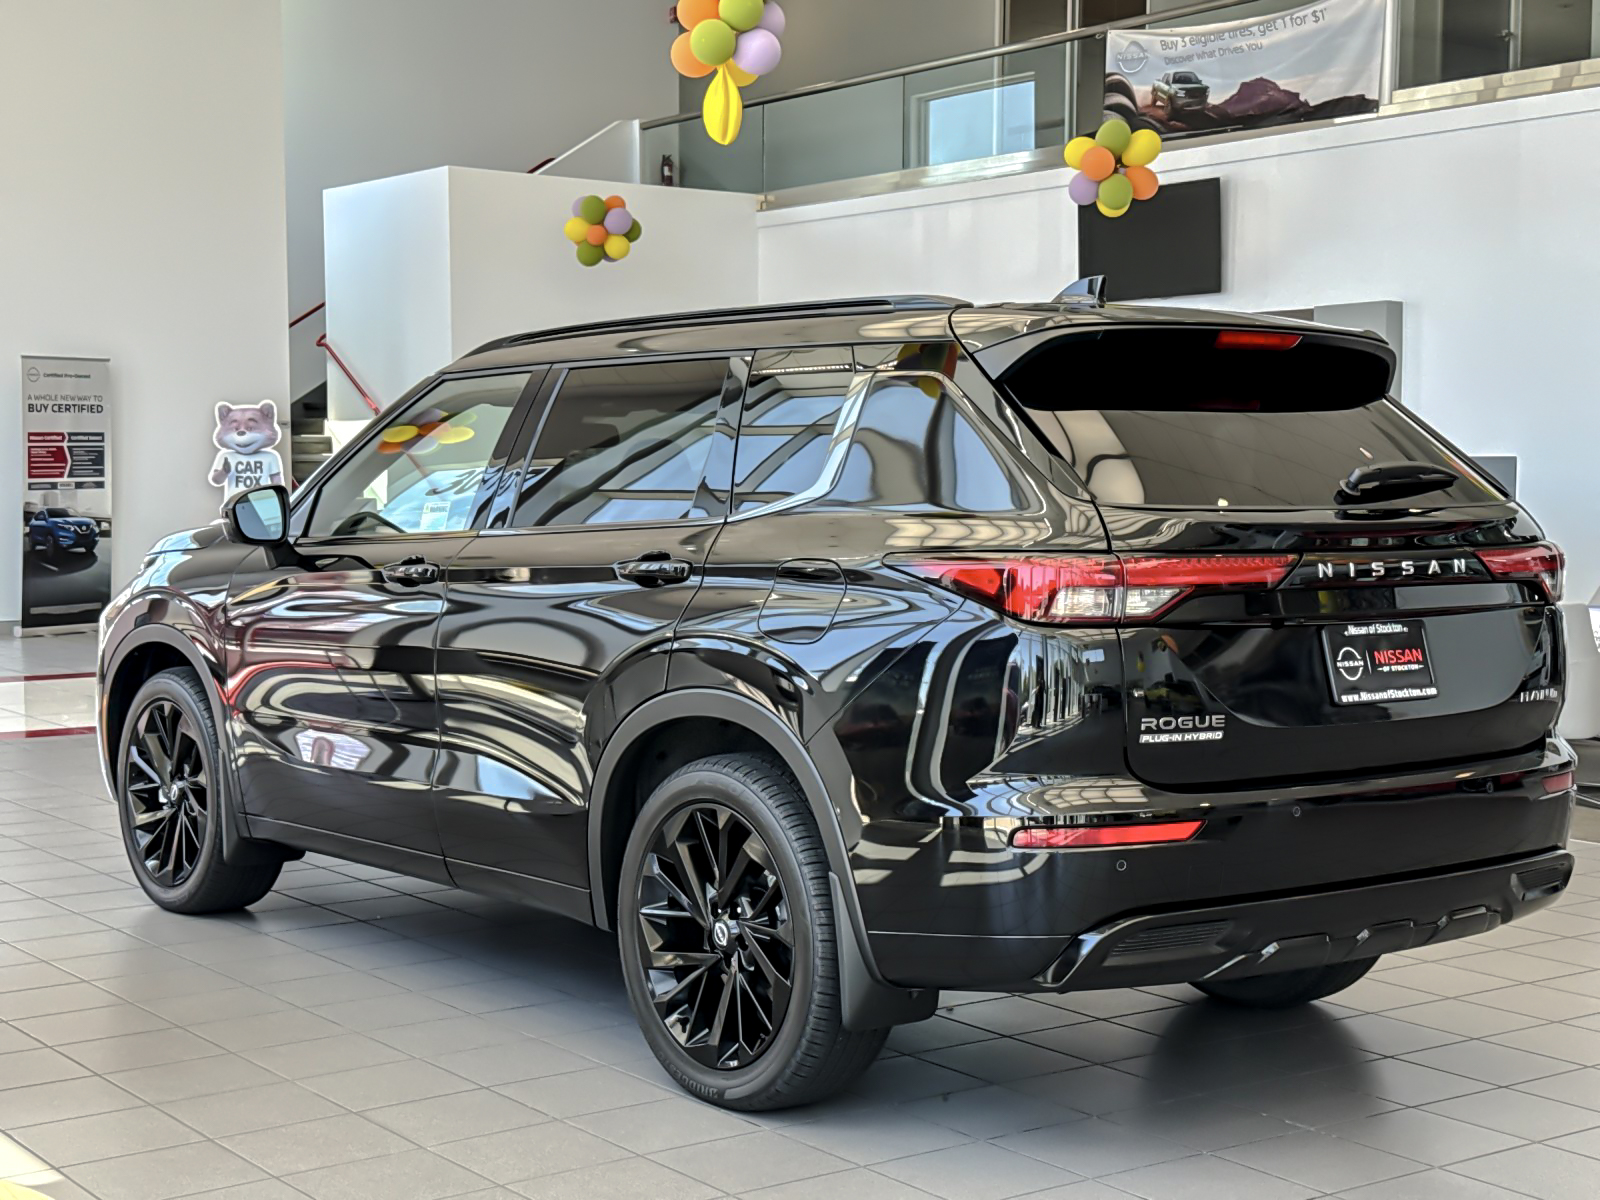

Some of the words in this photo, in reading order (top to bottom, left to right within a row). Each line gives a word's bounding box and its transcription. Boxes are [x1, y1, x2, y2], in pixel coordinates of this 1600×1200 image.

[1160, 39, 1179, 51] Buy
[1257, 20, 1279, 37] get
[1289, 13, 1309, 28] for
[1163, 53, 1196, 66] Discover
[1218, 45, 1245, 57] Drives
[1246, 41, 1263, 52] You
[28, 403, 49, 413] BUY
[51, 403, 104, 414] CERTIFIED
[235, 460, 264, 474] CAR
[235, 475, 262, 488] FOX
[1317, 558, 1466, 579] NISSAN
[1347, 624, 1369, 635] Nissan
[1368, 623, 1376, 633] of
[1375, 622, 1403, 633] Stockton
[1373, 648, 1423, 665] NISSAN
[1391, 664, 1419, 672] STOCKTON
[1341, 687, 1438, 703] www.NissanofStockton.com
[1140, 715, 1226, 731] ROGUE
[1141, 733, 1182, 743] PLUG-IN
[1184, 731, 1224, 741] HYBRID
